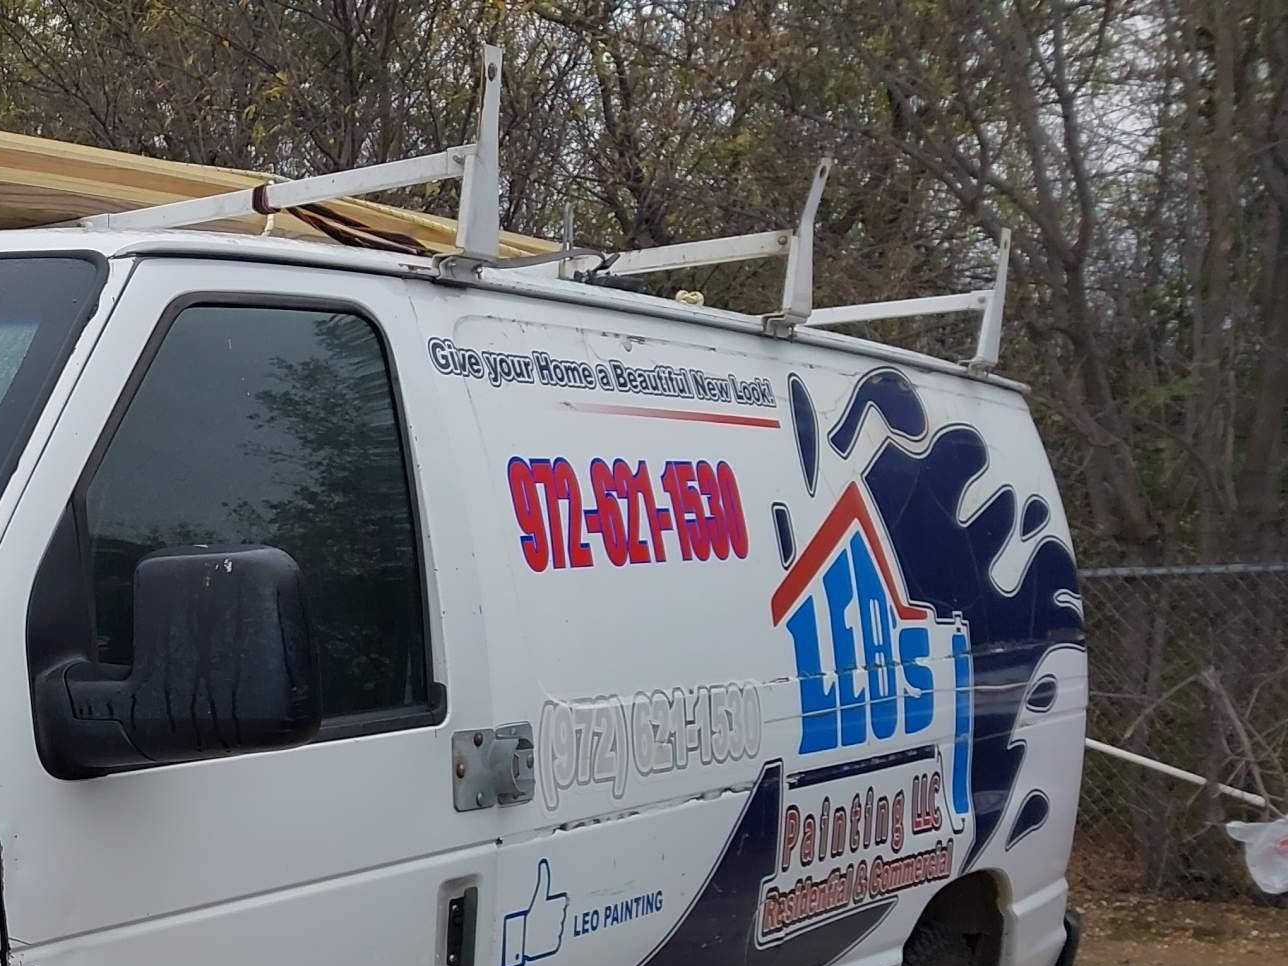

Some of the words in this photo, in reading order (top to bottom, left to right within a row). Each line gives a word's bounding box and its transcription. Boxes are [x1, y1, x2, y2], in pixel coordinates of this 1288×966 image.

[428, 337, 484, 378] Give
[486, 352, 533, 387] your
[533, 351, 595, 389] Home
[596, 369, 613, 390] a
[614, 361, 691, 398] Beautiful
[691, 370, 731, 401] New
[732, 375, 776, 407] Look!
[507, 456, 749, 572] 972-621-1530
[538, 694, 628, 811] (972)
[632, 682, 761, 776] 621-1530
[782, 787, 904, 872] Painting
[912, 771, 942, 835] LLC
[574, 912, 600, 937] LEO
[604, 890, 663, 927] PAINTING
[762, 862, 852, 935] Residential
[853, 860, 868, 902] &
[869, 840, 953, 898] Commercial
